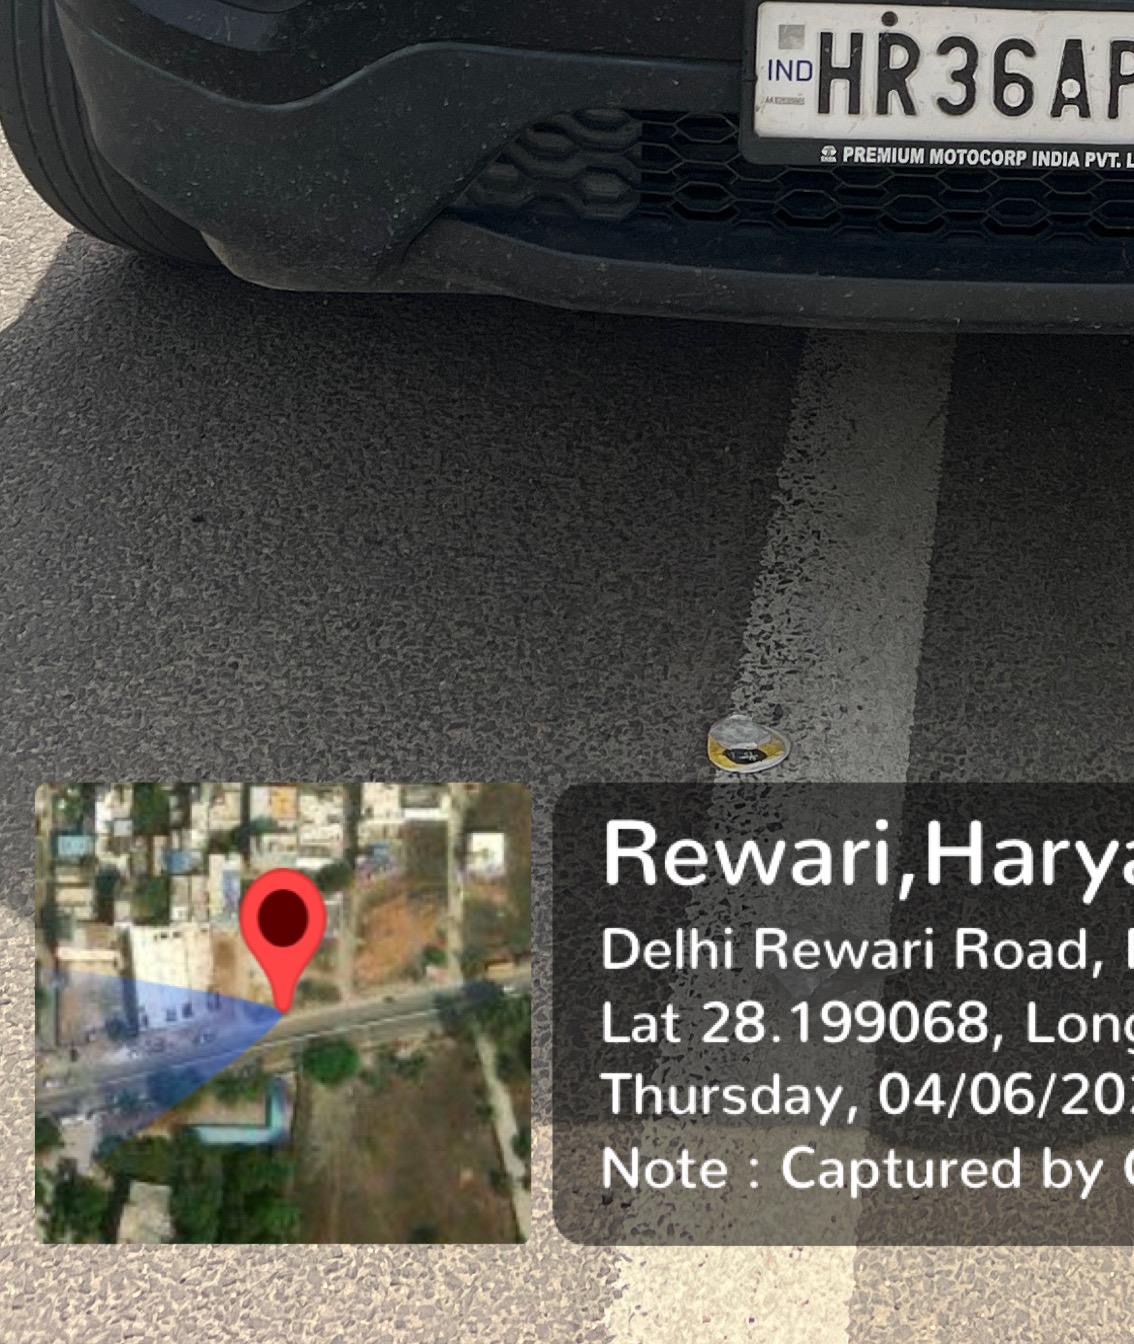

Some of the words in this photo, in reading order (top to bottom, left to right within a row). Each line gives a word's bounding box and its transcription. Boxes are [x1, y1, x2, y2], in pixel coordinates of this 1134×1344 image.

[767, 58, 814, 82] IND
[842, 146, 925, 164] PREMIUM
[929, 148, 1027, 166] MOTOCORP
[1032, 150, 1081, 167] INDIA
[1085, 150, 1122, 168] PVT.
